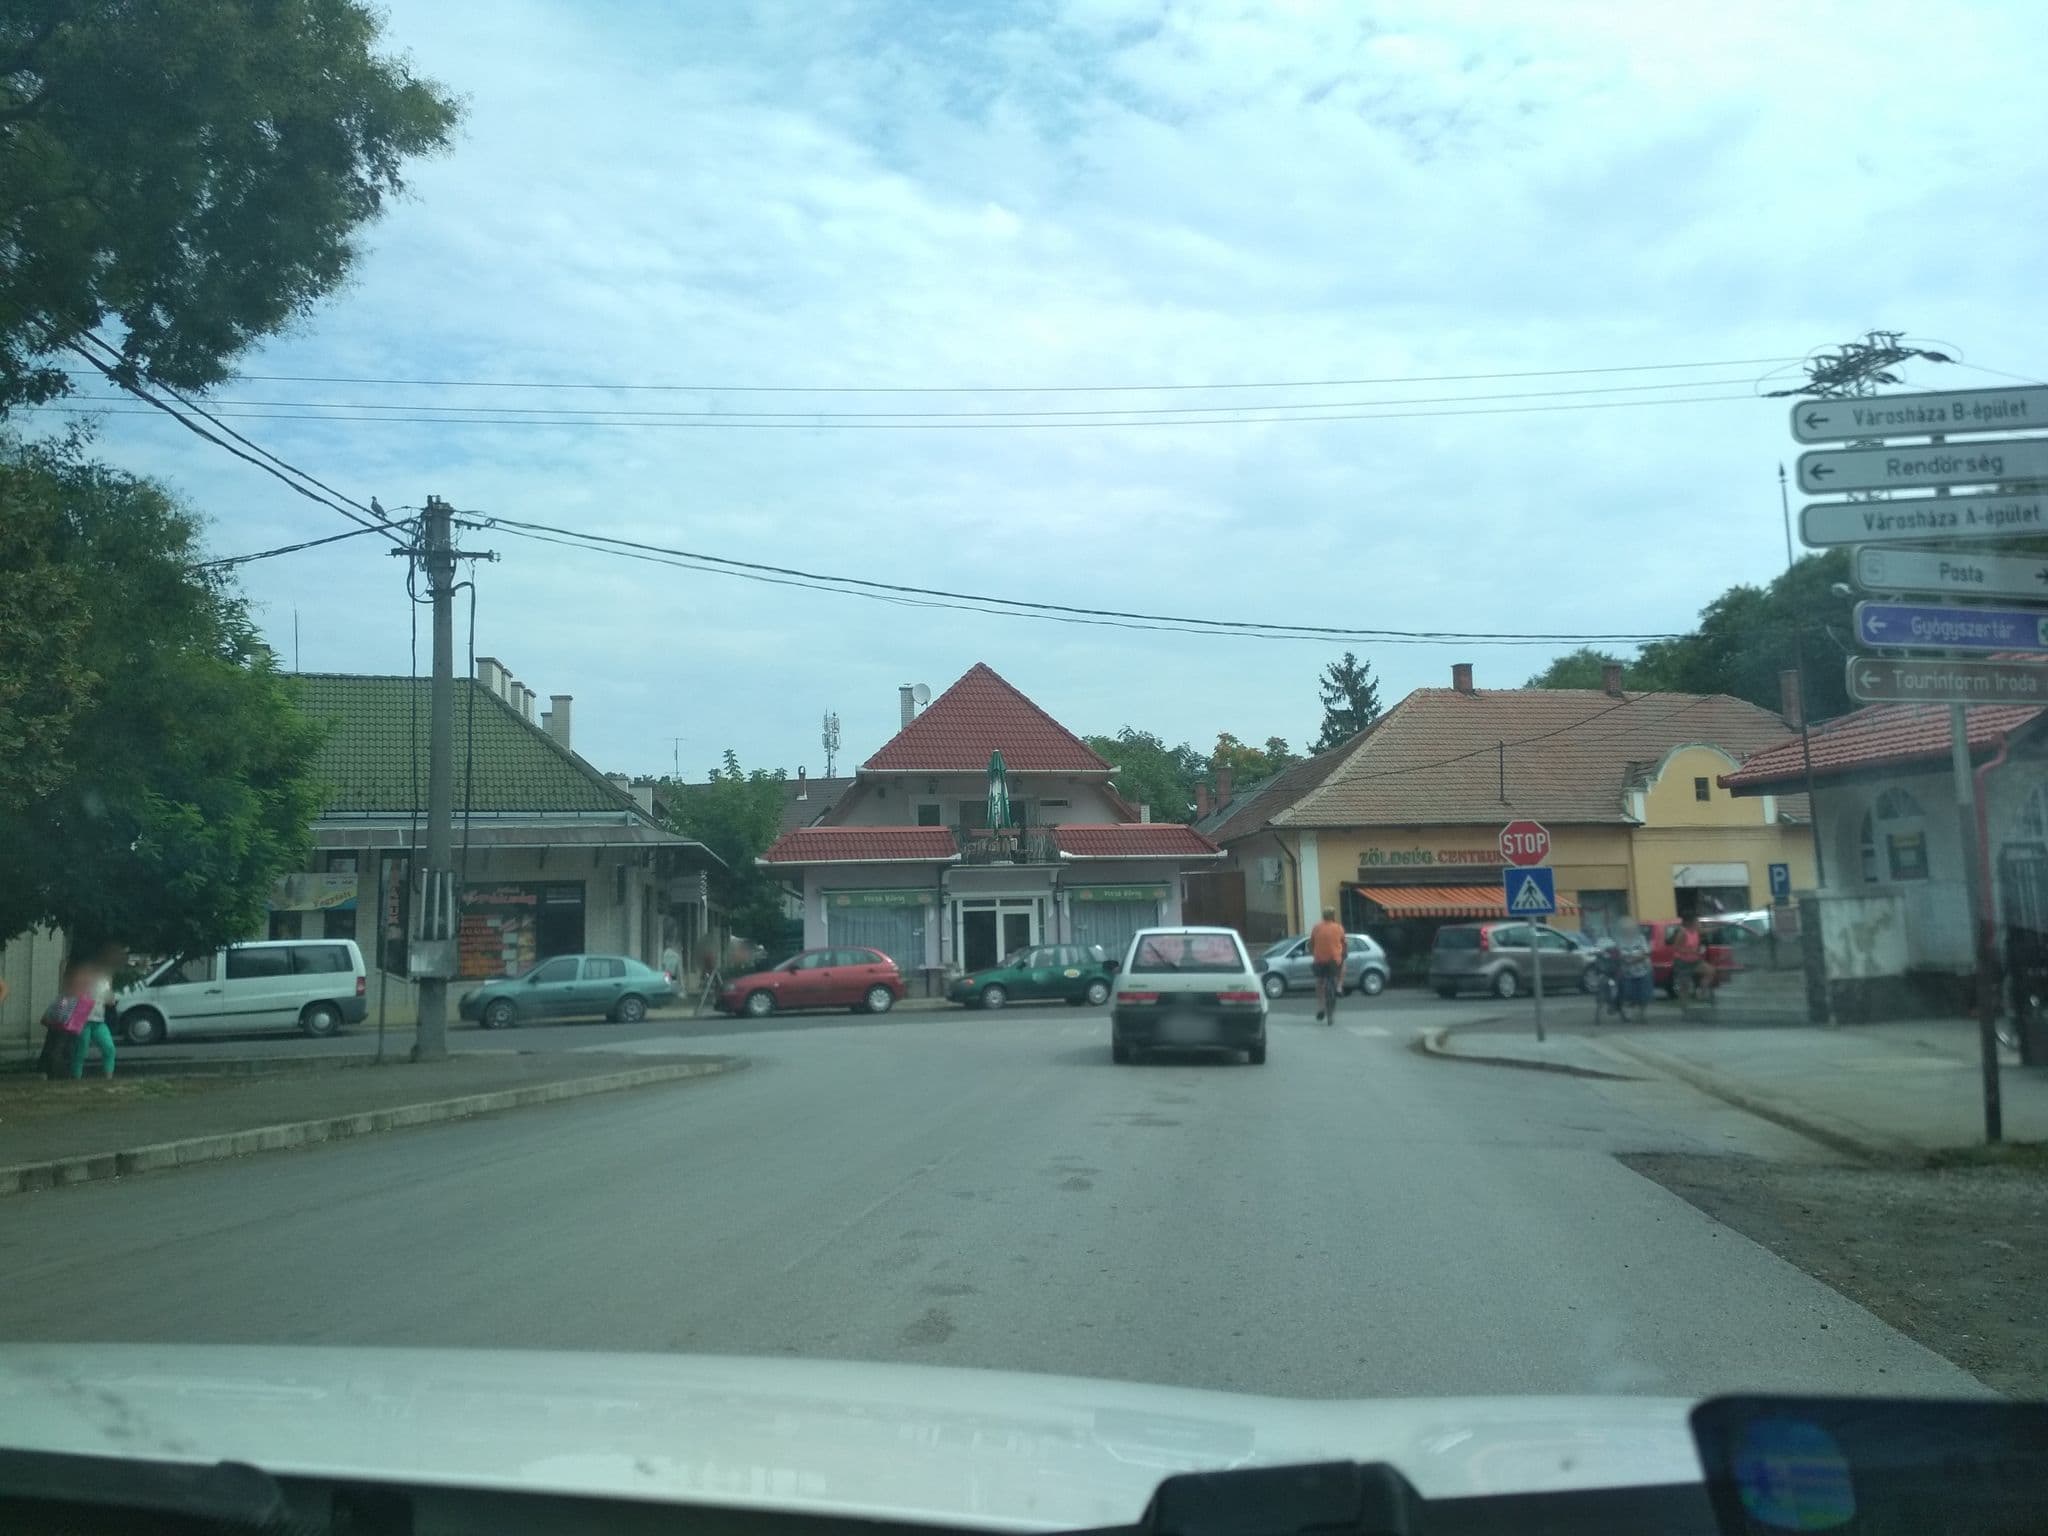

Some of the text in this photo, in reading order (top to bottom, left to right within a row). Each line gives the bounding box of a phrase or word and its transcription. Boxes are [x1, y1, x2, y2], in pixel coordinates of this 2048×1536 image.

[1852, 399, 2027, 426] Városháza B-épület
[1886, 453, 2005, 476] Rendőrség
[1863, 503, 2041, 531] Városháza A-épület
[1939, 562, 1985, 584] Posta
[1910, 615, 2016, 640] Gyógyszertár
[1893, 669, 2037, 692] Tourinform Iroda
[1503, 832, 1546, 855] STOP
[1772, 866, 1786, 891] P
